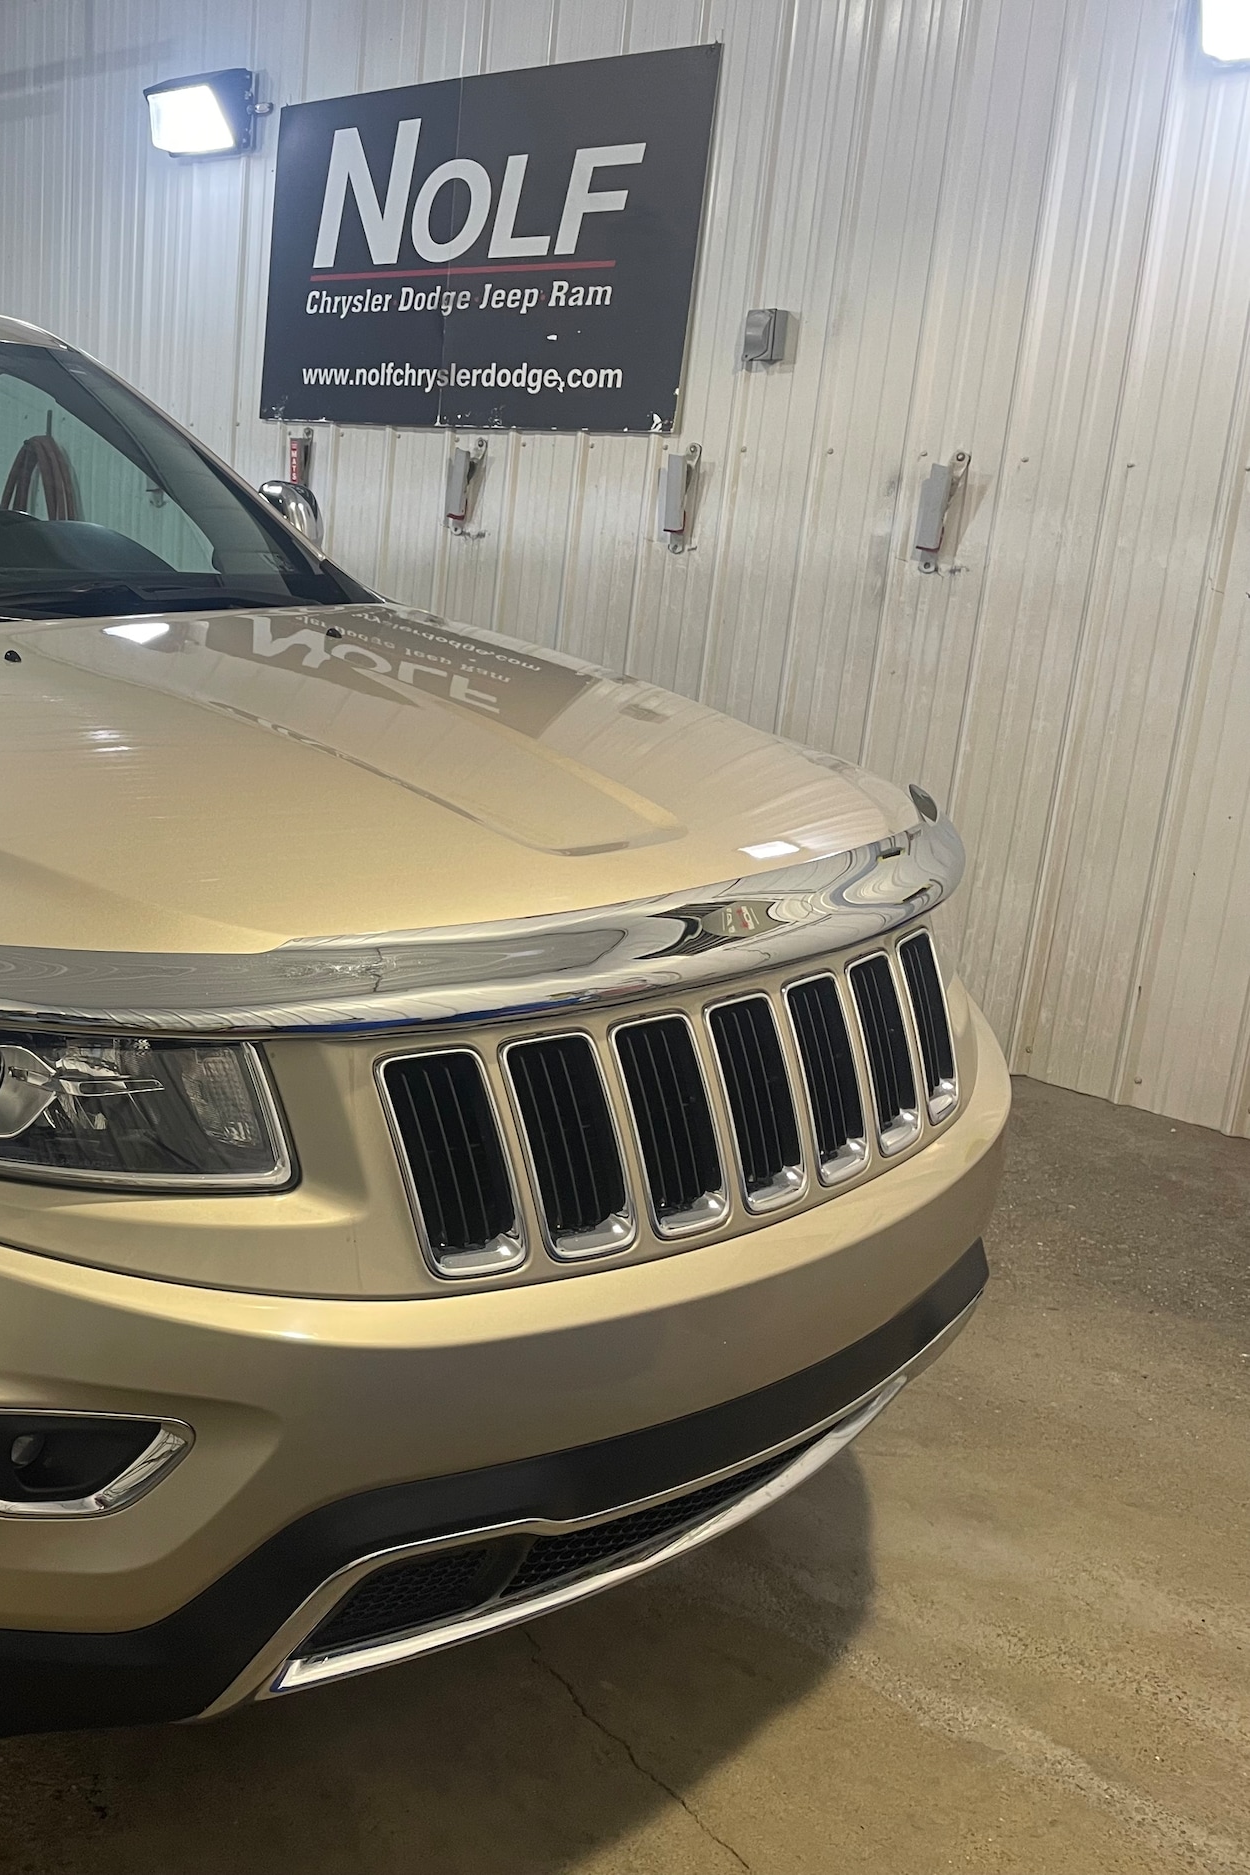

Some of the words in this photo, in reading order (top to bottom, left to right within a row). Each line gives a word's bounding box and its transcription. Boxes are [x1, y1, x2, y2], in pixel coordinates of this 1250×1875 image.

[312, 118, 646, 269] NOLF
[306, 290, 392, 319] Chrysler
[398, 286, 471, 316] Dodge
[479, 284, 540, 314] Jeep
[548, 280, 613, 307] Ram
[302, 362, 623, 394] www.nolfchryslerdodge.com
